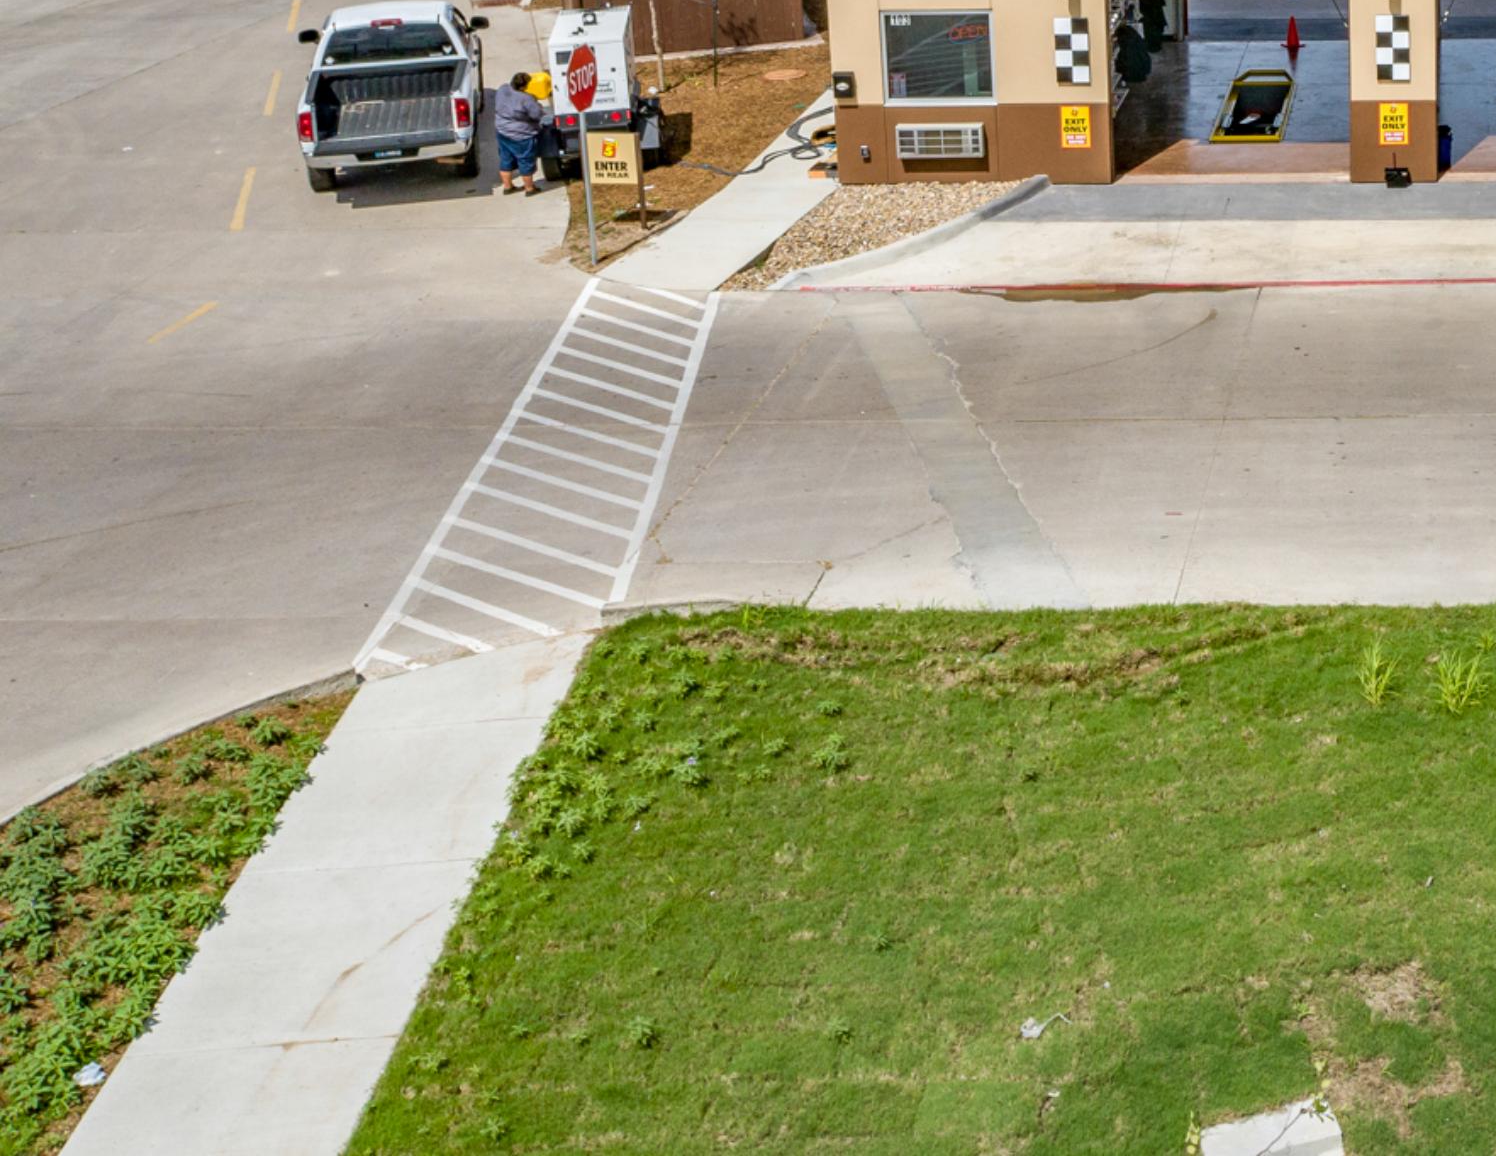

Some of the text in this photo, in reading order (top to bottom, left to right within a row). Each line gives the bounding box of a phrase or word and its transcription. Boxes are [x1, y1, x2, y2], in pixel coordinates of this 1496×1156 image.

[568, 62, 595, 96] STOP
[1064, 117, 1086, 125] EXIT
[1383, 115, 1404, 123] EXIT
[594, 160, 628, 171] ENTER
